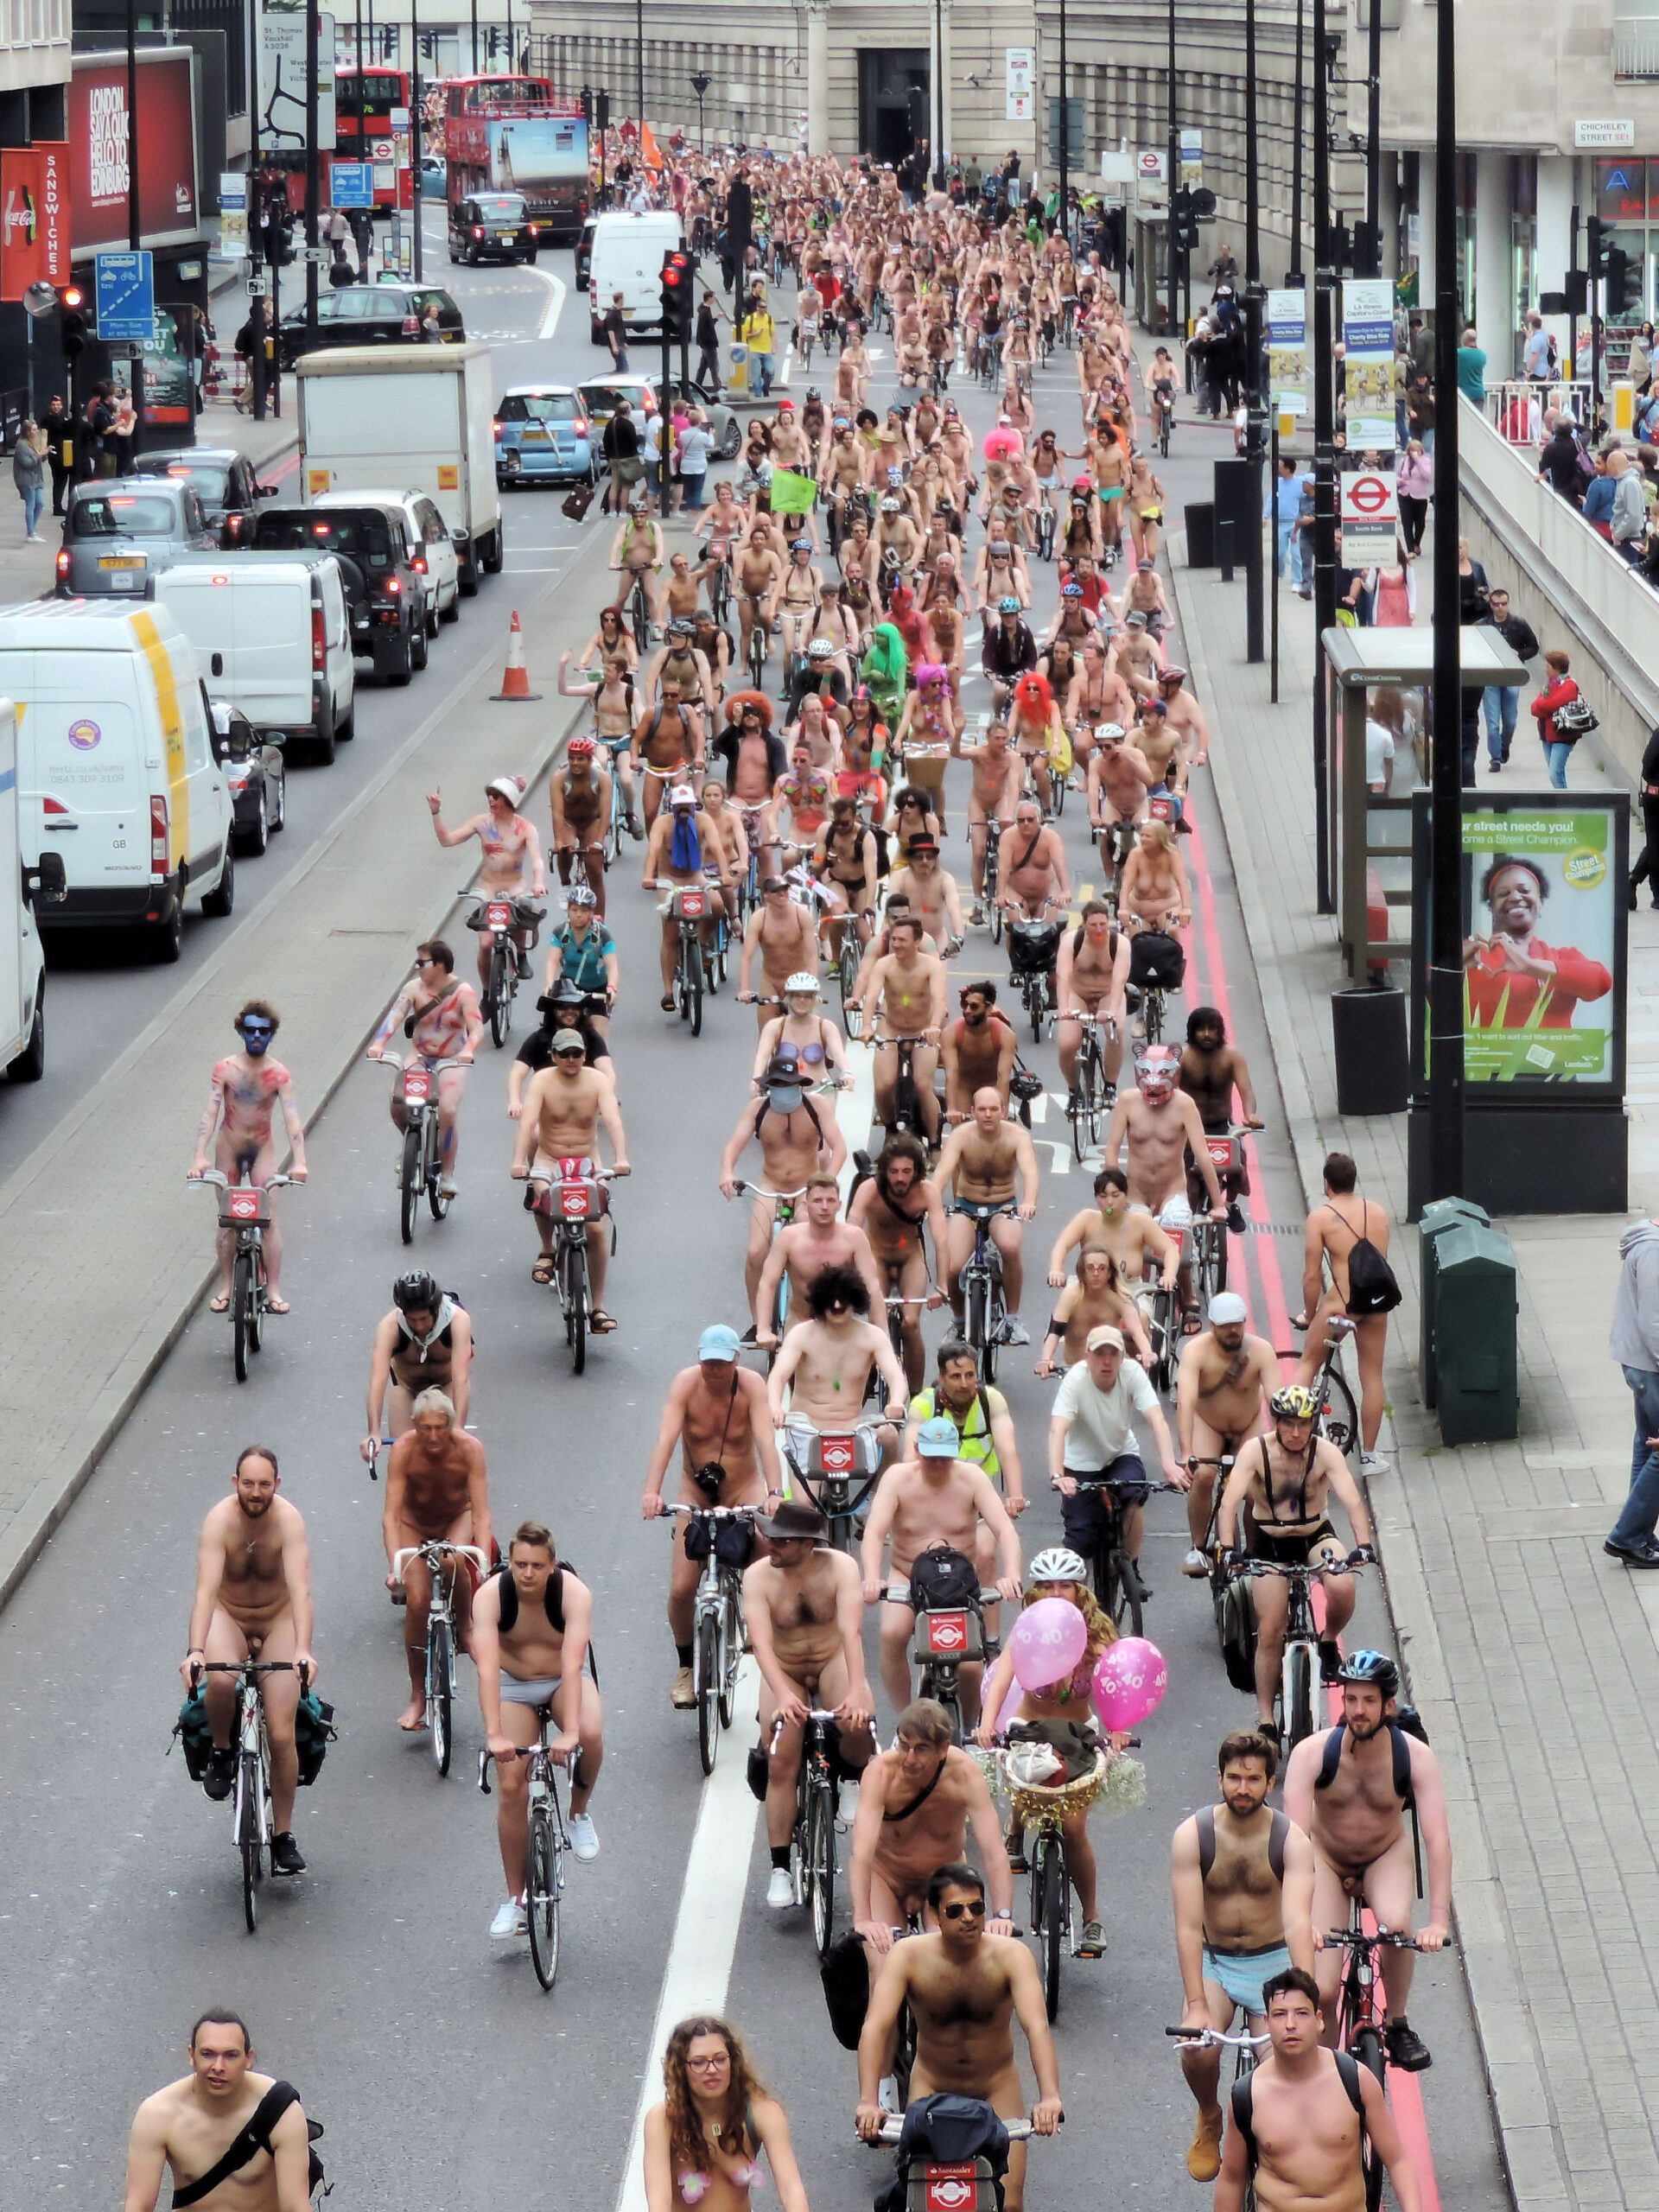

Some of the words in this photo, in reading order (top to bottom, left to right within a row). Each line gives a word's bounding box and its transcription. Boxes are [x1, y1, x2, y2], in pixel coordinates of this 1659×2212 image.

[91, 86, 124, 113] LONDON
[91, 113, 105, 143] SAY
[111, 111, 130, 140] QUIC
[91, 140, 114, 168] HELLO
[115, 139, 127, 165] TO
[92, 164, 130, 197] EDINBURG
[44, 156, 59, 275] SANDWICHES
[143, 340, 165, 351] OU
[1474, 822, 1508, 832] street
[1510, 821, 1546, 832] needs
[1549, 822, 1573, 834] you!
[112, 840, 126, 849] GB
[1487, 836, 1493, 844] a
[1496, 834, 1523, 844] Street
[1569, 855, 1599, 871] Street
[1107, 1649, 1128, 1665] 40
